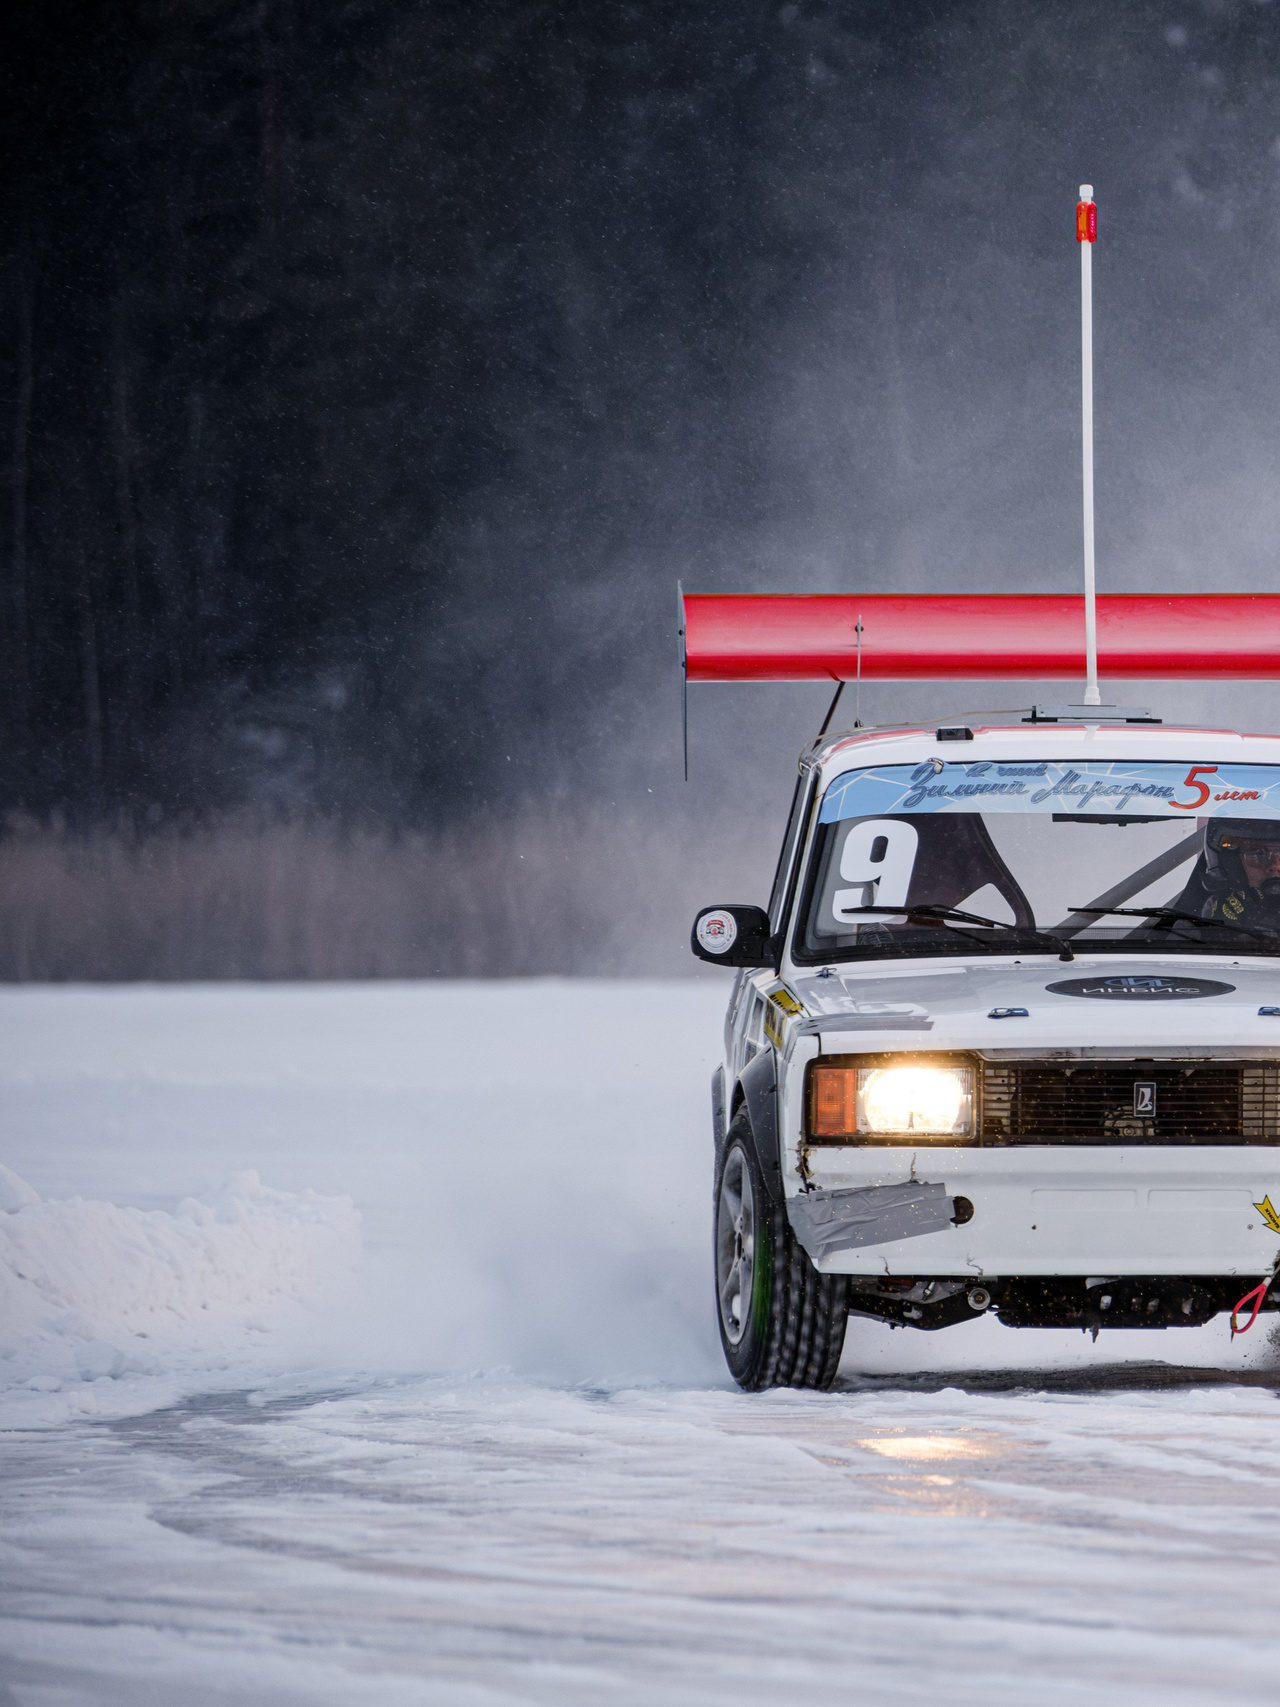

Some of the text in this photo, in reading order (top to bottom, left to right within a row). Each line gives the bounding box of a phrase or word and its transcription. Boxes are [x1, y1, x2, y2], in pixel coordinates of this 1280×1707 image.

[903, 757, 1262, 811] Зимний Марафон 5 лет
[832, 819, 919, 924] 9
